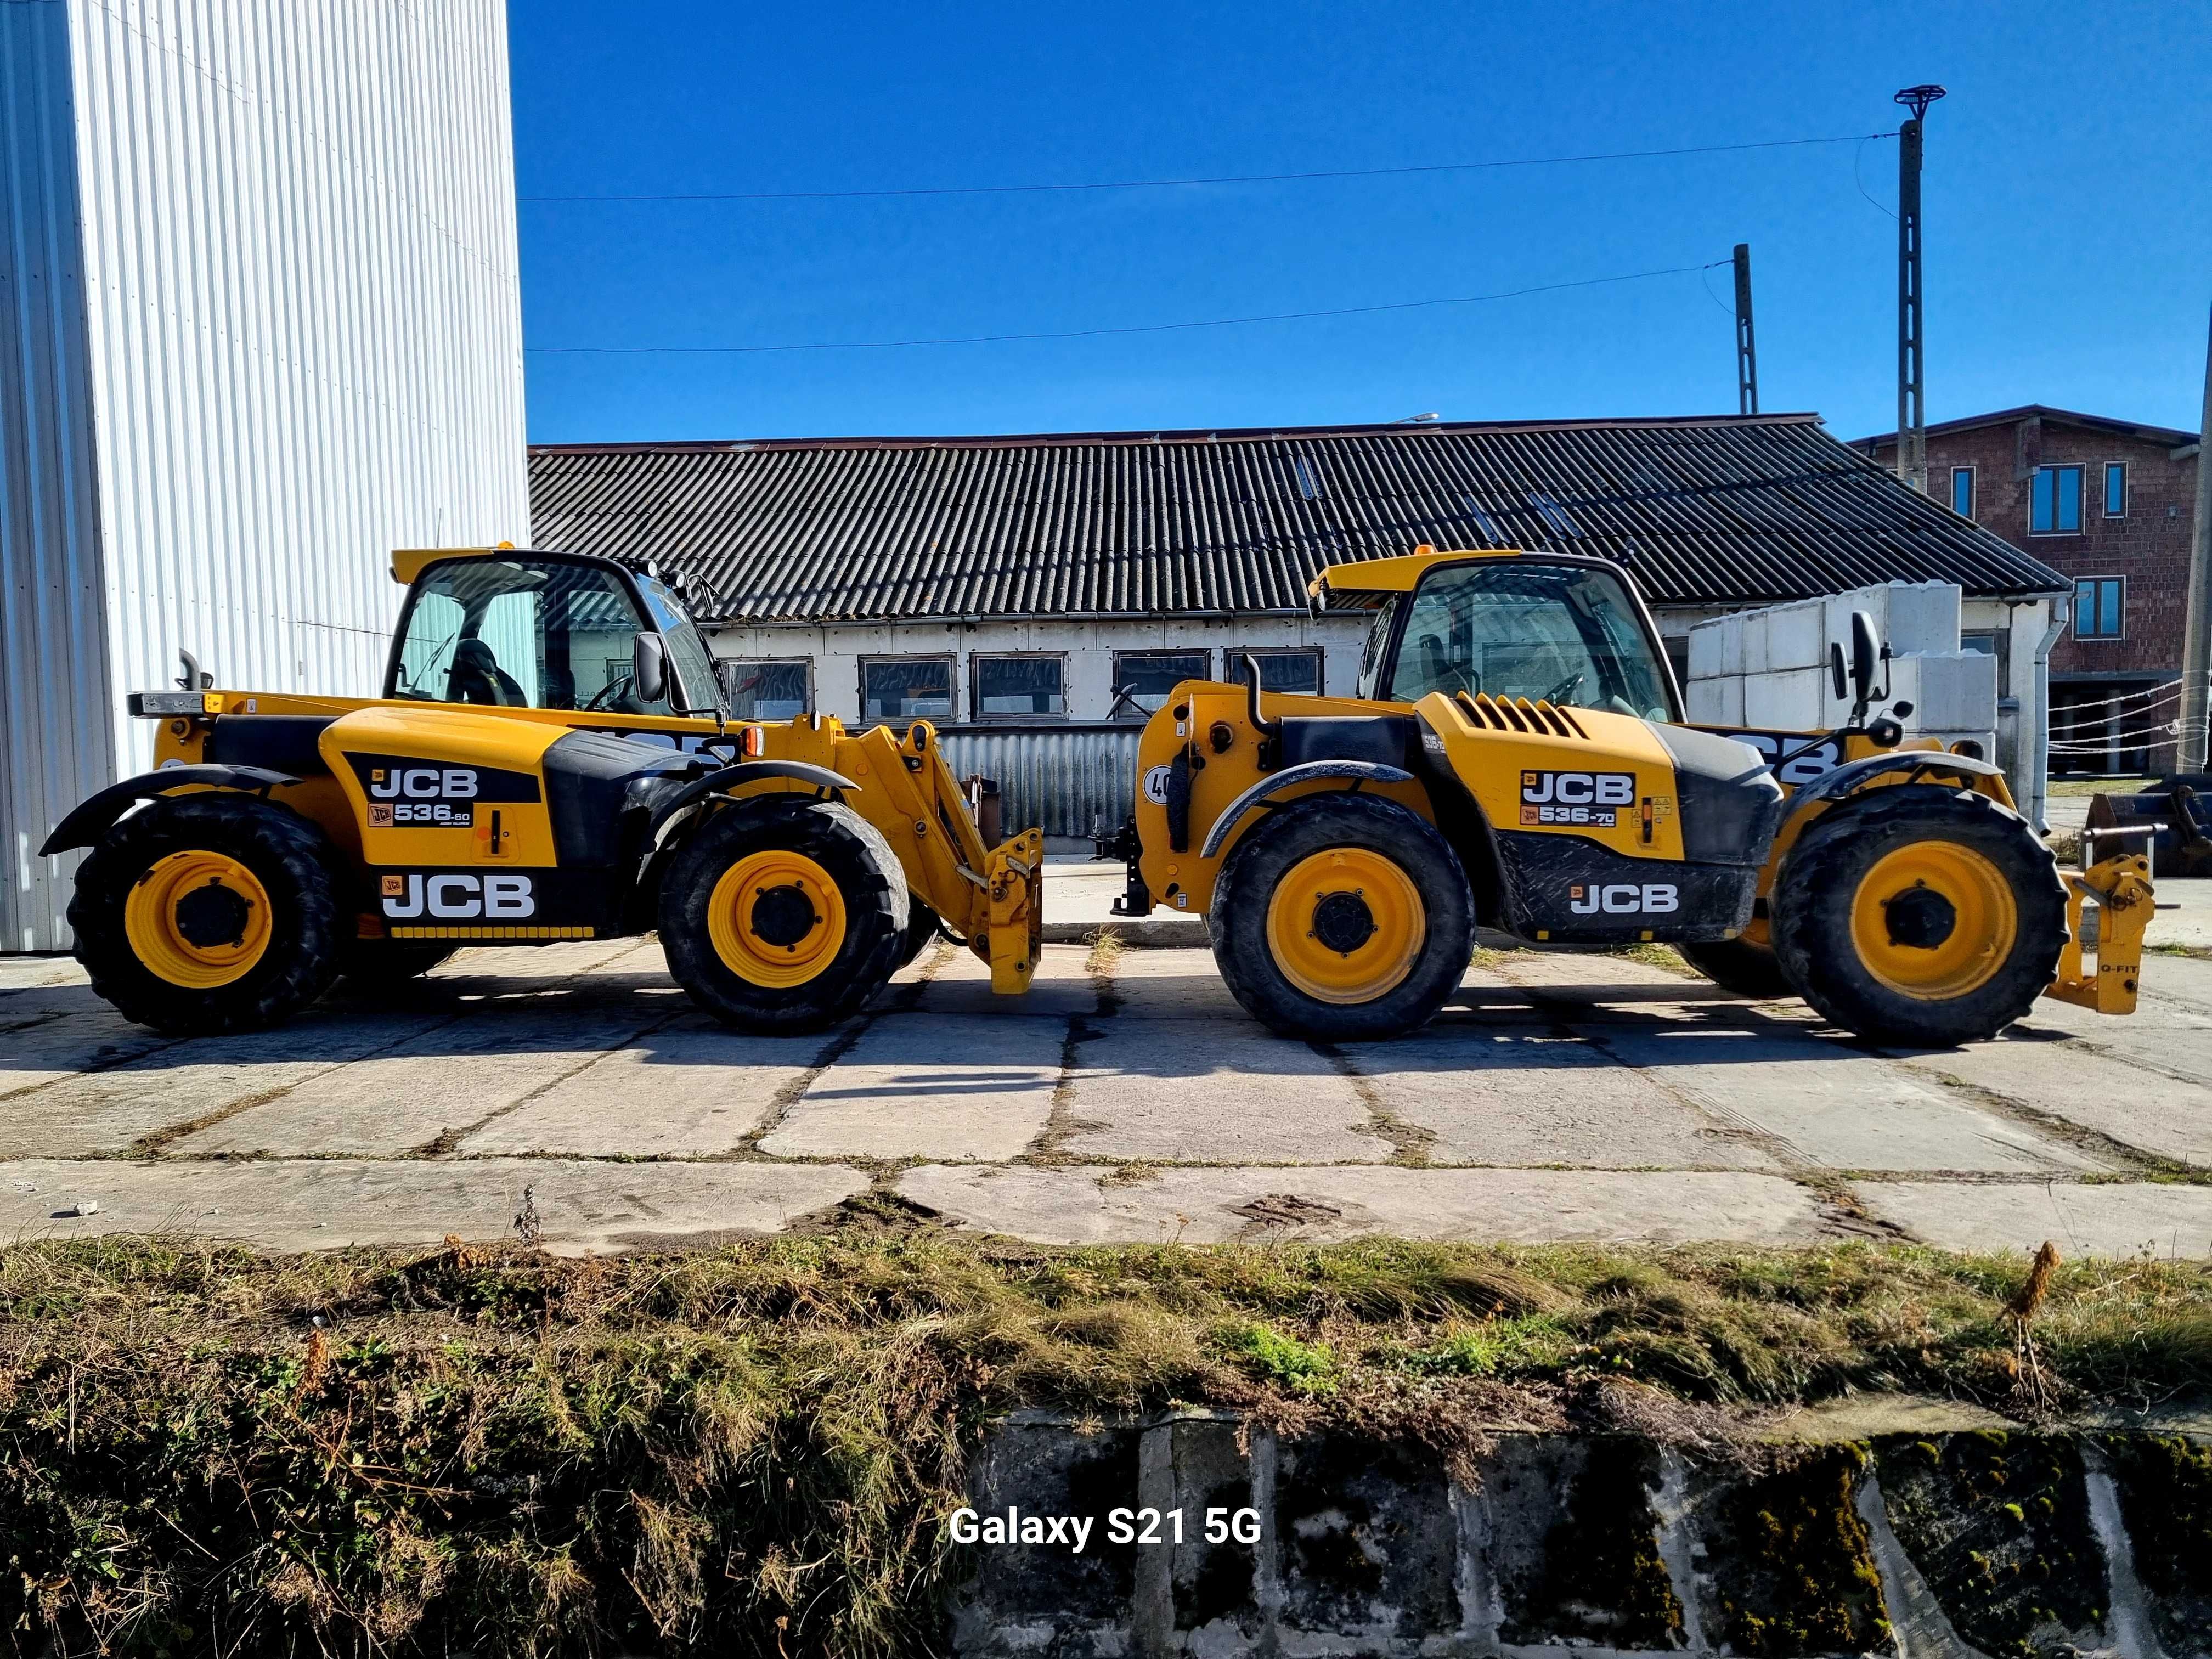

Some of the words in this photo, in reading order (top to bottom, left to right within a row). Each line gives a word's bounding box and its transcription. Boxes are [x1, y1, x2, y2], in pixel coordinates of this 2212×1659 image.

[371, 770, 478, 797] JCB
[1523, 774, 1633, 804] JCB
[394, 804, 470, 821] 536-60
[1539, 806, 1615, 823] 536-70
[383, 874, 535, 918] JCB
[1570, 884, 1679, 914] JCB
